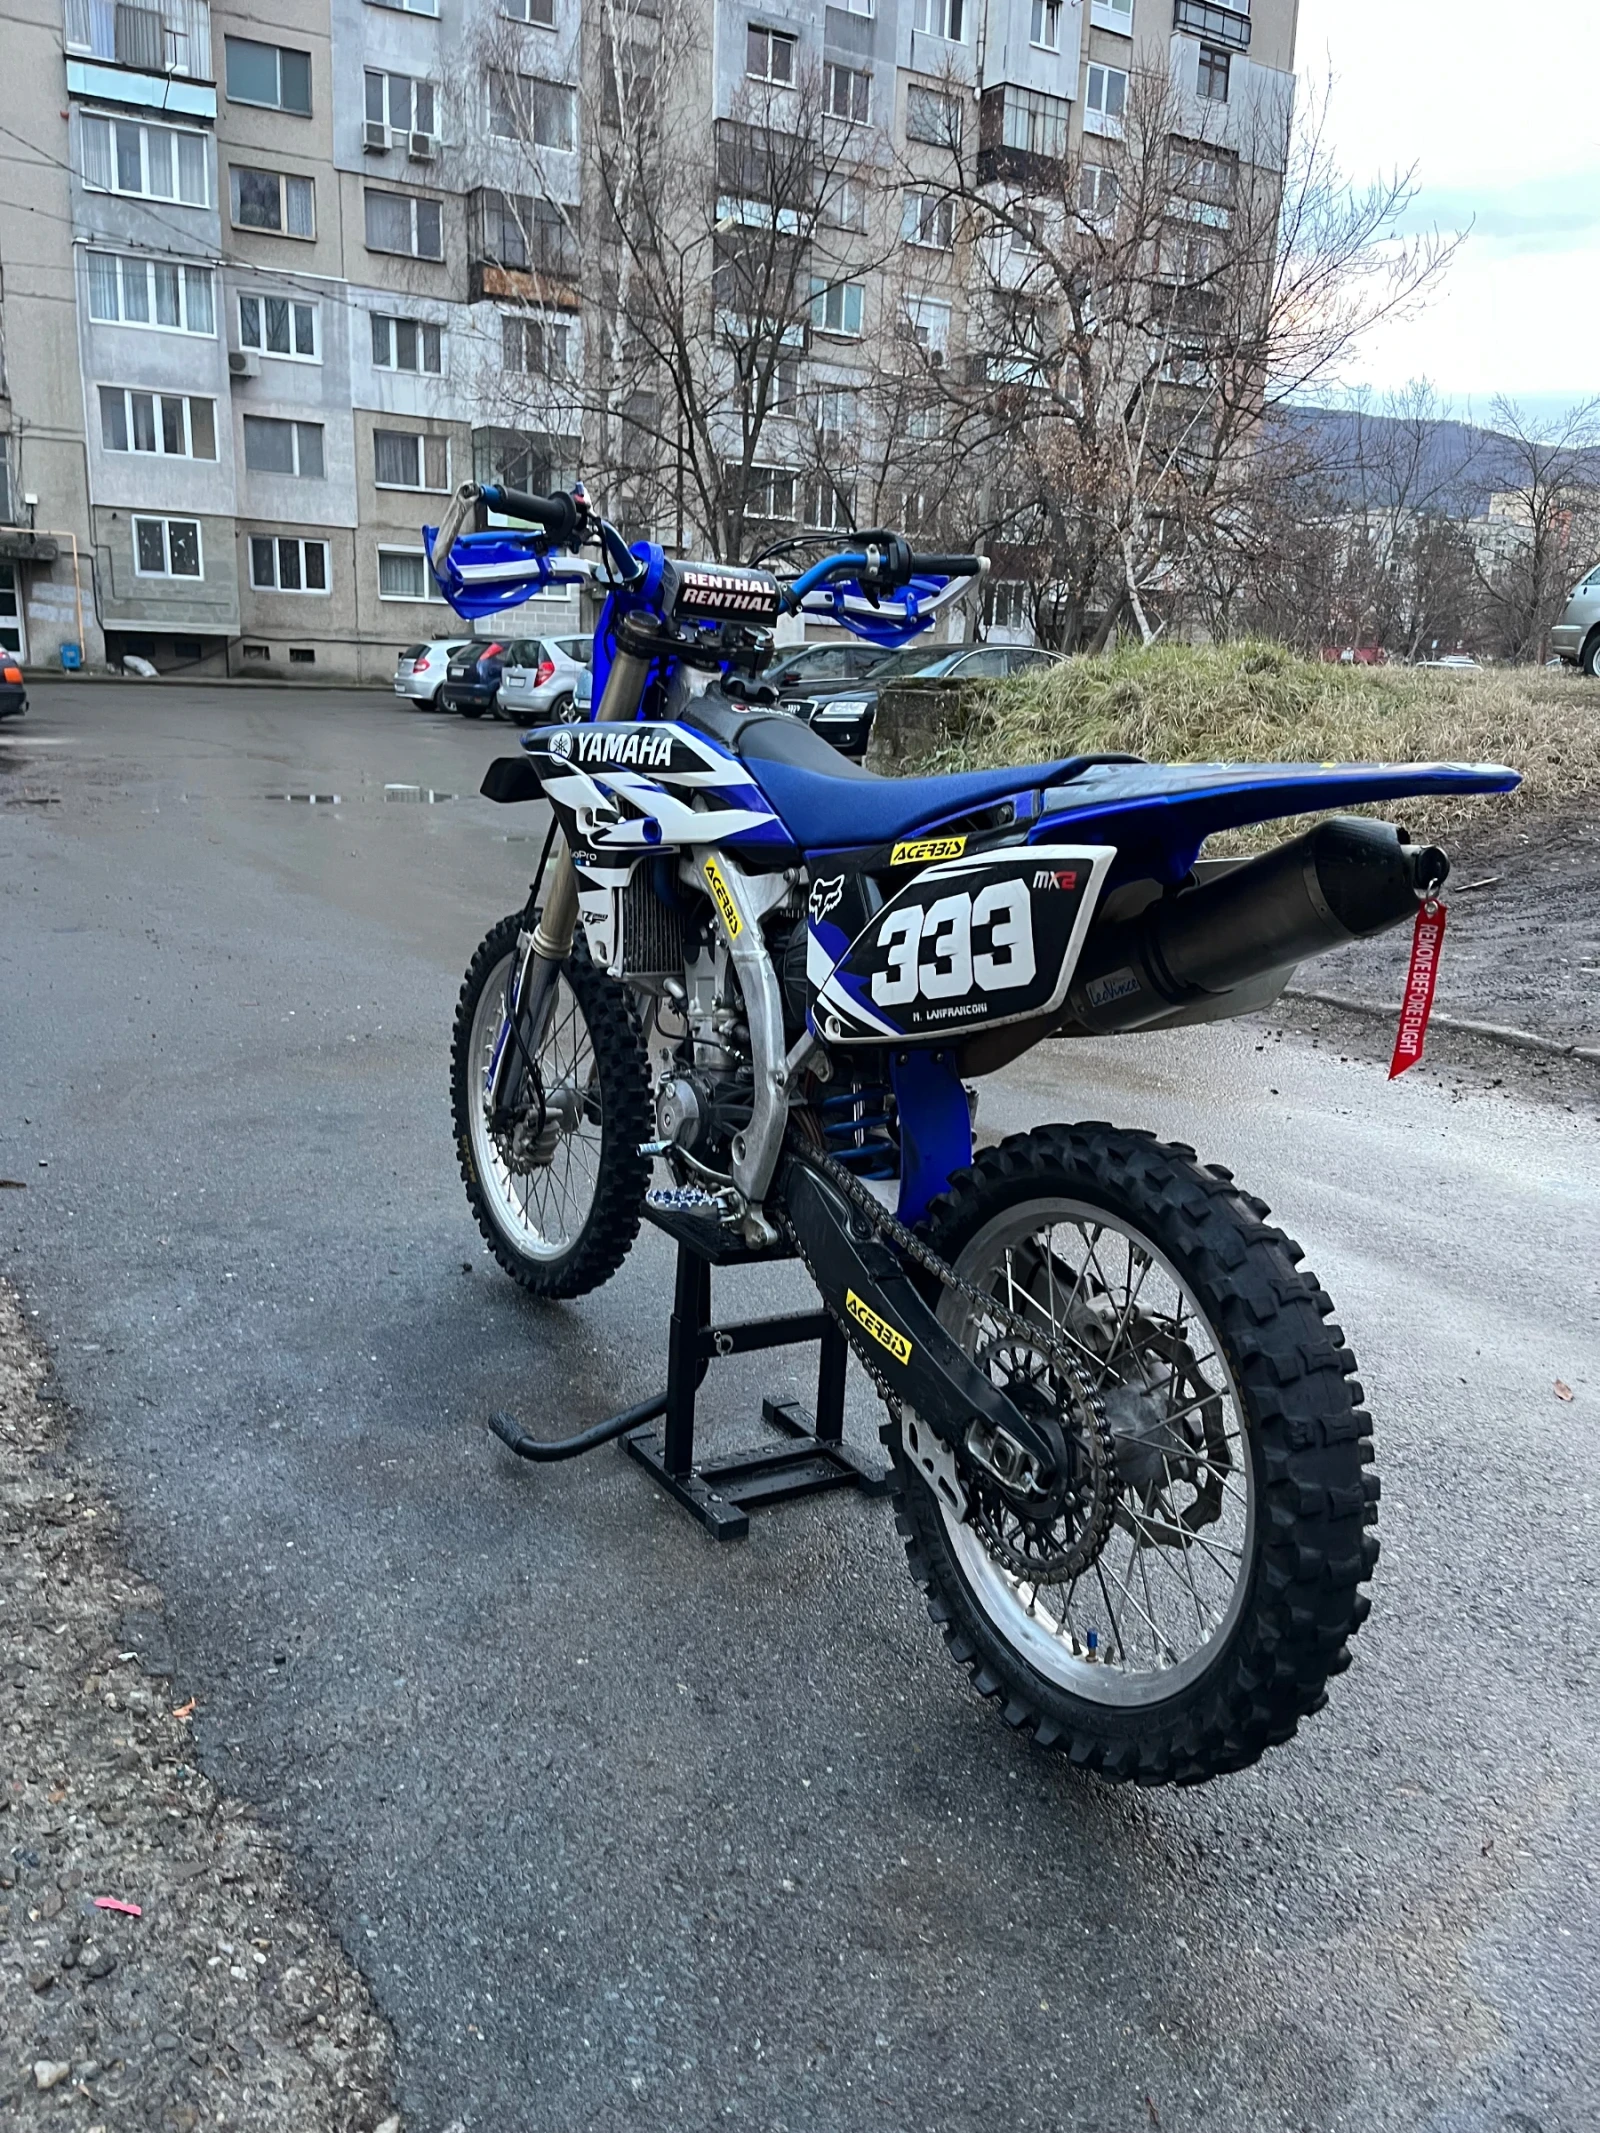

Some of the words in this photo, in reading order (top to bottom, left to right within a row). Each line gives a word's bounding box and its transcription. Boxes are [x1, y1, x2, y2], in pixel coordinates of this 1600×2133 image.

[682, 588, 775, 612] RENTHAL
[683, 571, 776, 594] RENTHAL
[578, 732, 674, 767] YAMAHA
[1032, 870, 1077, 890] MX2
[871, 877, 1037, 1007] 333
[1416, 923, 1438, 971] REMOVE
[1407, 972, 1430, 1017] BEFORE
[1399, 1017, 1422, 1056] FLIGHT
